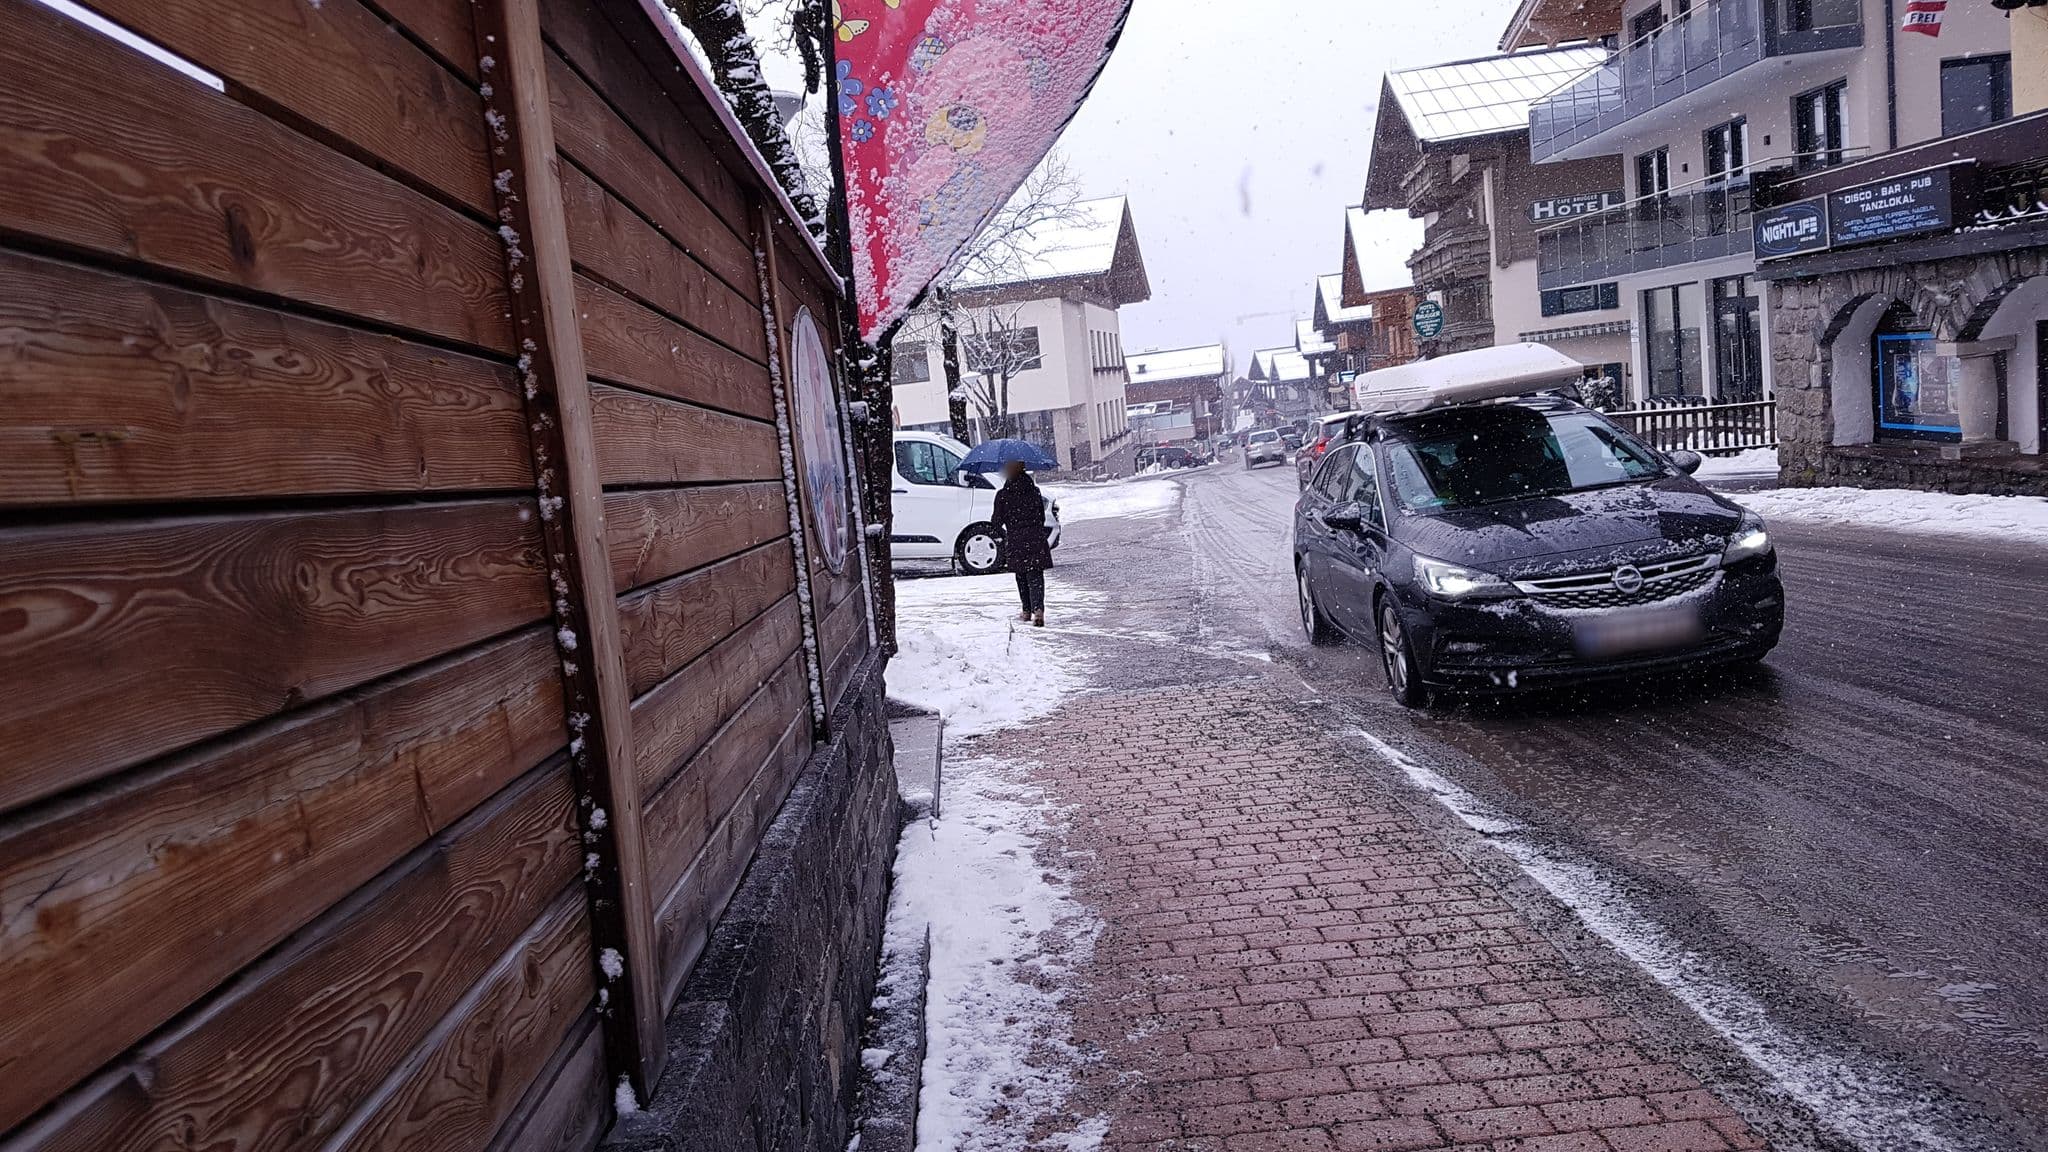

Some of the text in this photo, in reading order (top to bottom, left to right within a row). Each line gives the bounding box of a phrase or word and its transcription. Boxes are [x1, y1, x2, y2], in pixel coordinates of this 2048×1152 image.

[1910, 12, 1936, 23] FREI
[1844, 177, 1932, 204] DISCO BAR PUB
[1860, 194, 1916, 213] TANZLOKAL
[1762, 216, 1818, 244] NIGHTLIFE
